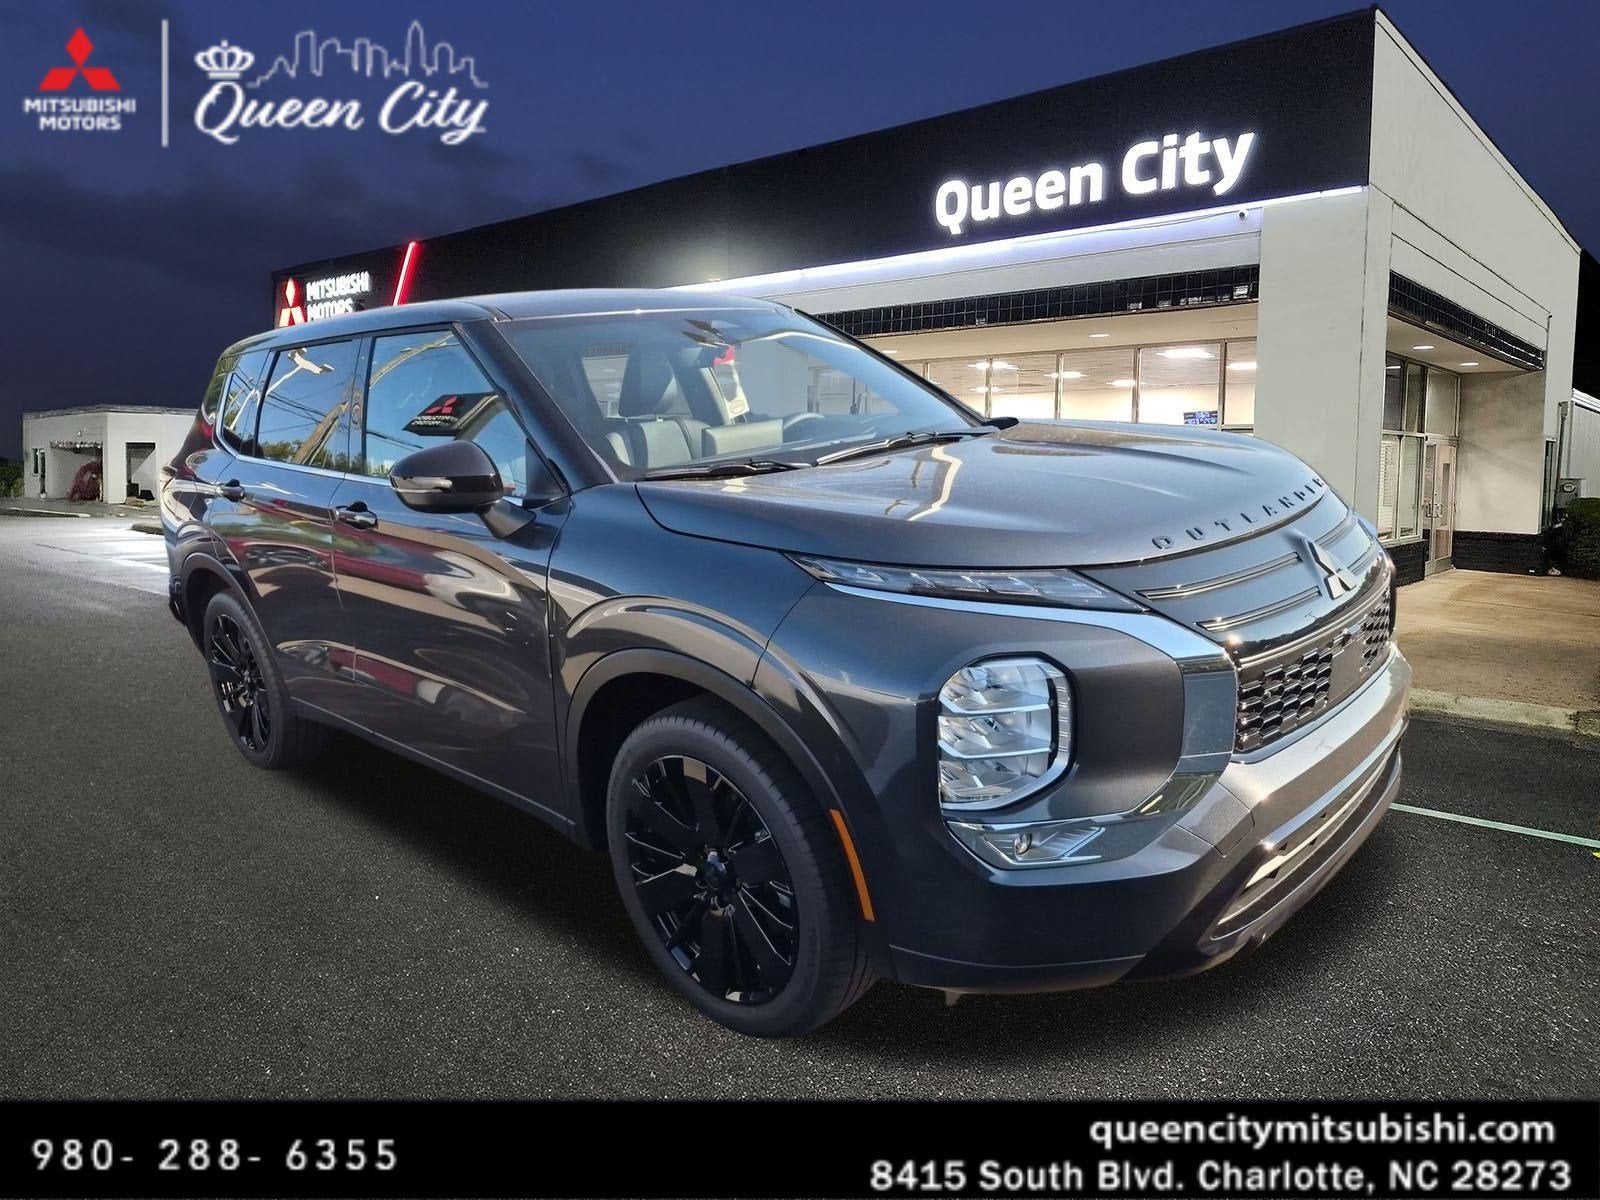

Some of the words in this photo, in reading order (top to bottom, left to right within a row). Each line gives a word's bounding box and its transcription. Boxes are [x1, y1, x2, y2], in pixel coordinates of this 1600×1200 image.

[935, 162, 1103, 234] Queen
[1121, 131, 1255, 196] City
[306, 271, 370, 302] MITSUBISHI
